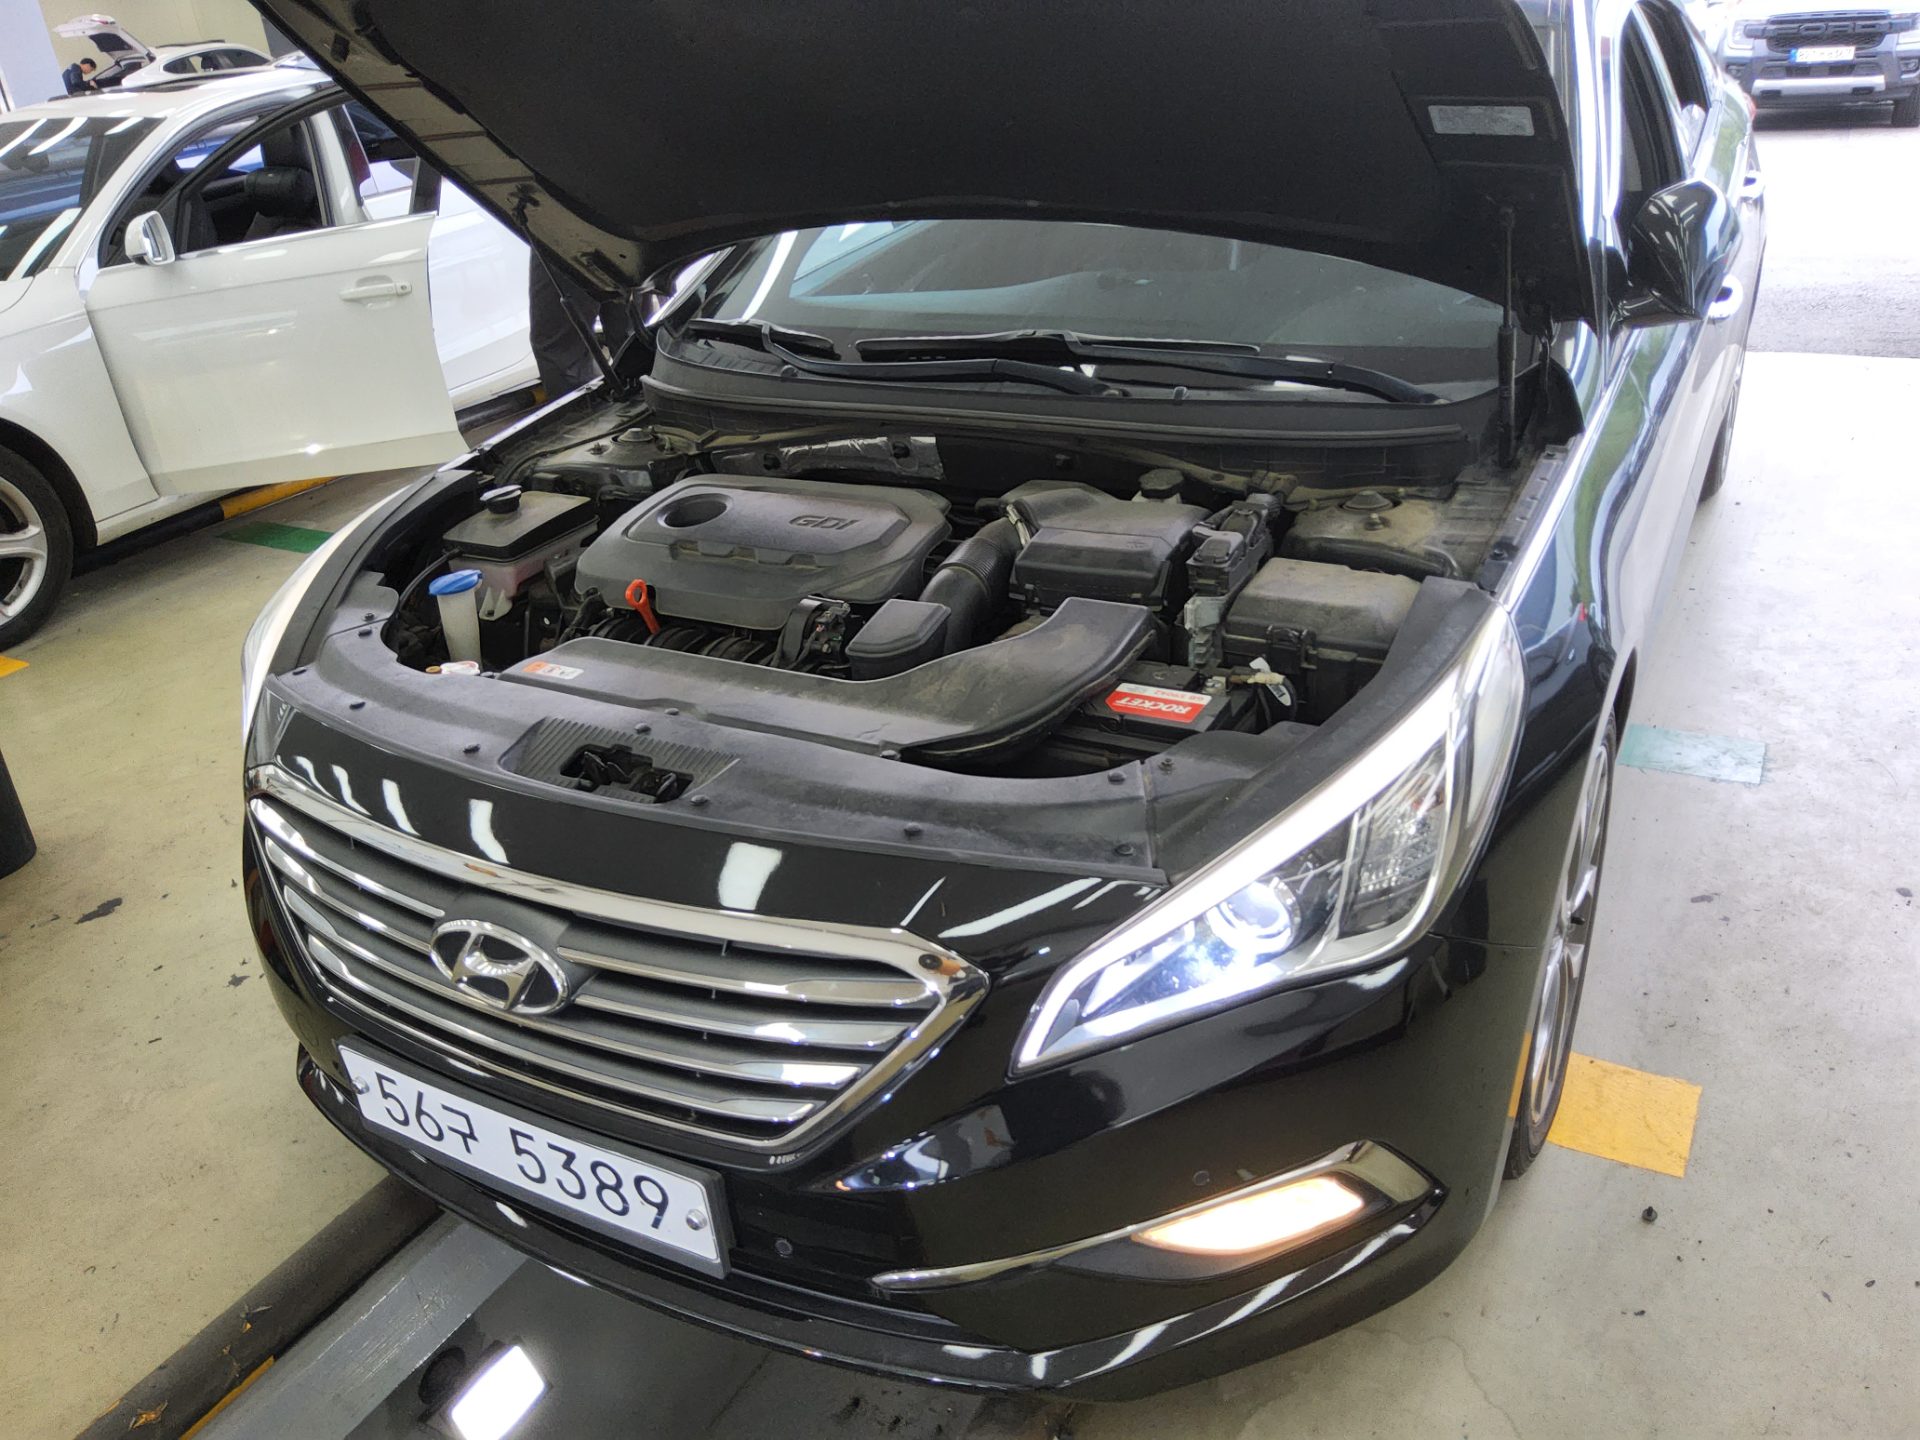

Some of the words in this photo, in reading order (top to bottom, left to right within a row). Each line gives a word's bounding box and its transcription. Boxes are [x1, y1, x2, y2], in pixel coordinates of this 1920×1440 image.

[1766, 22, 1887, 36] FORD
[789, 515, 861, 530] GDI
[1116, 697, 1192, 714] ROCKET
[375, 1072, 479, 1154] 56구
[509, 1127, 670, 1229] 5389
